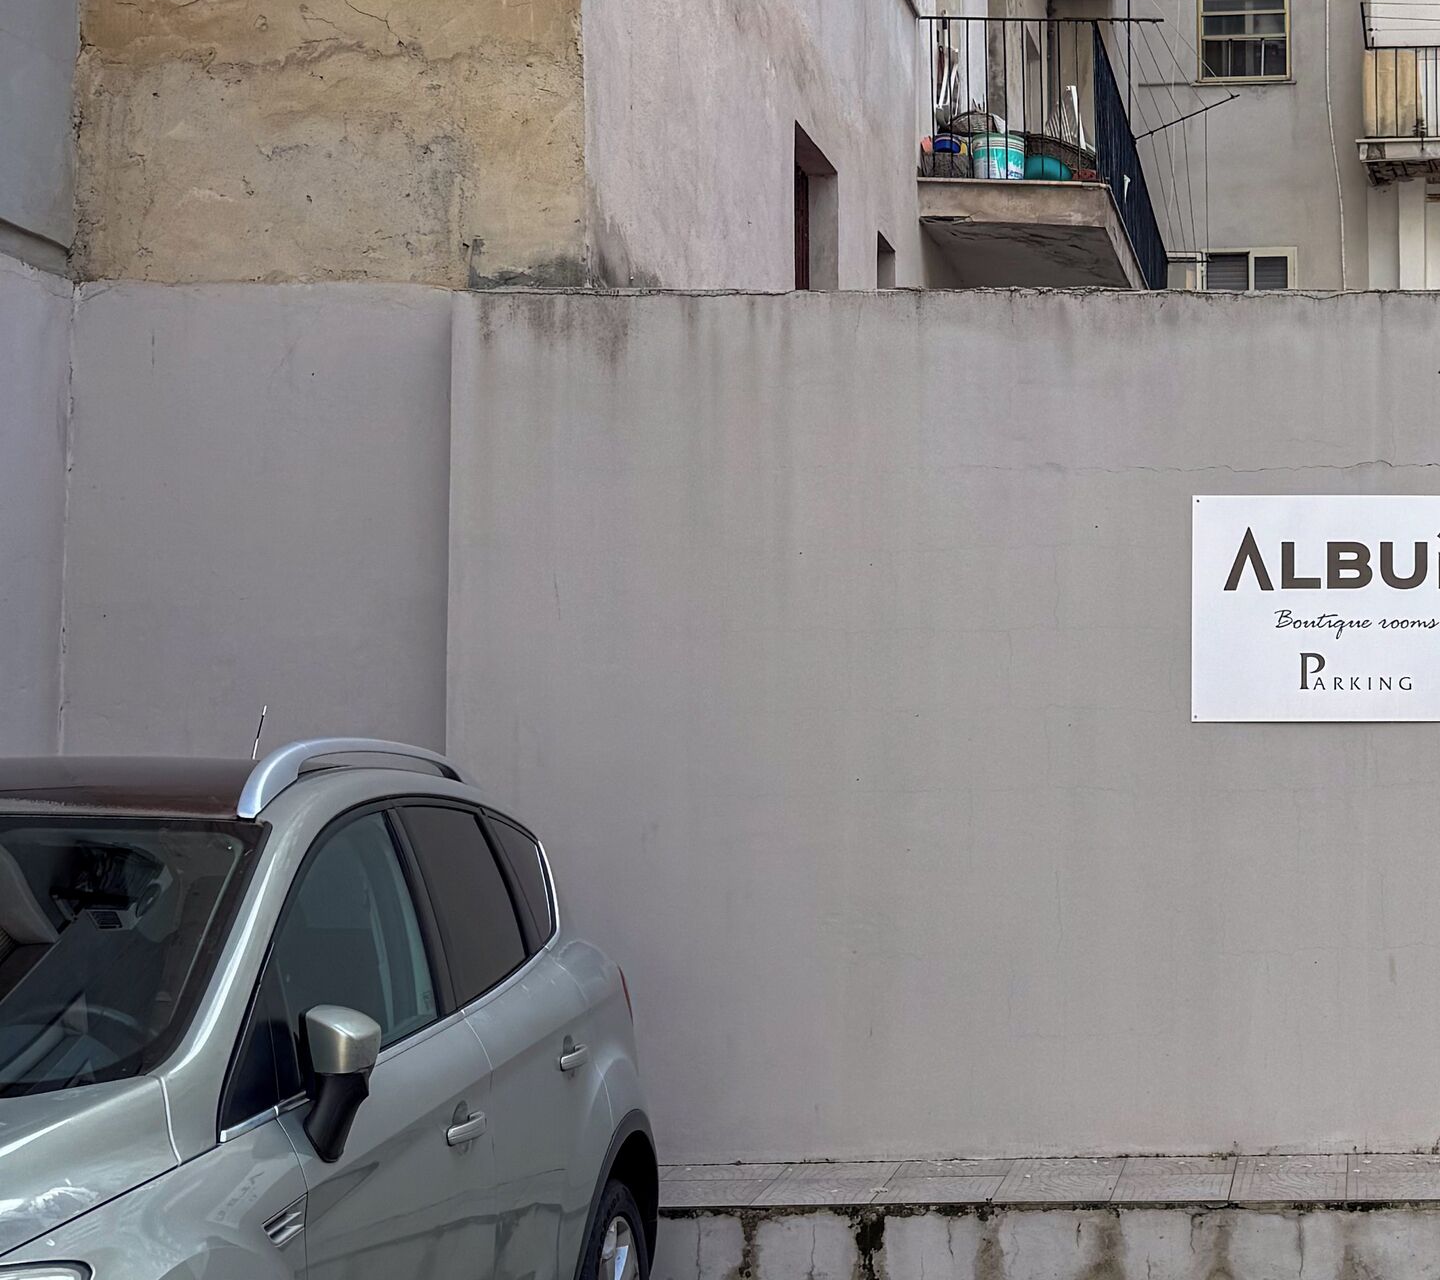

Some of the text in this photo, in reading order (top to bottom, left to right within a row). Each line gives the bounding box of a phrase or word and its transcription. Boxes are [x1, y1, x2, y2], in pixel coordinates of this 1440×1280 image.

[1274, 609, 1440, 640] Boutique rooms
[1299, 652, 1413, 691] PARKING
